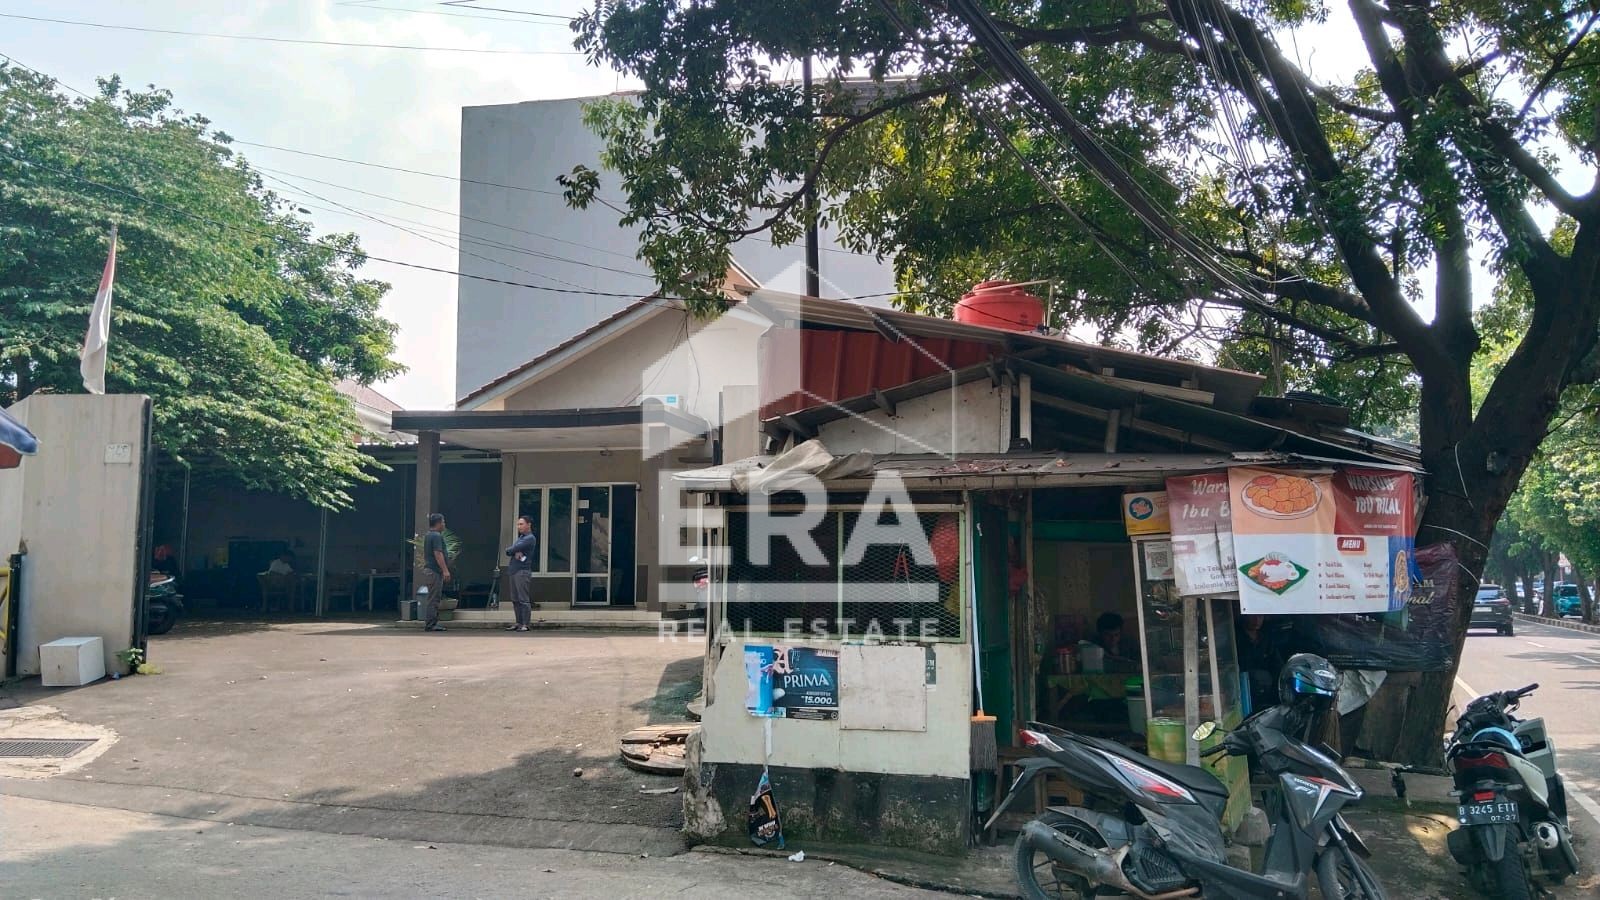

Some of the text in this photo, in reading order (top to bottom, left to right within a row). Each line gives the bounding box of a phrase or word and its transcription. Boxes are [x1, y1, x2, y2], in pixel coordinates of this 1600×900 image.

[1355, 496, 1401, 515] IBU BILAL
[1341, 539, 1361, 549] MENU
[783, 673, 830, 689] PRIMA
[1459, 806, 1465, 816] B
[1469, 804, 1493, 815] 3245
